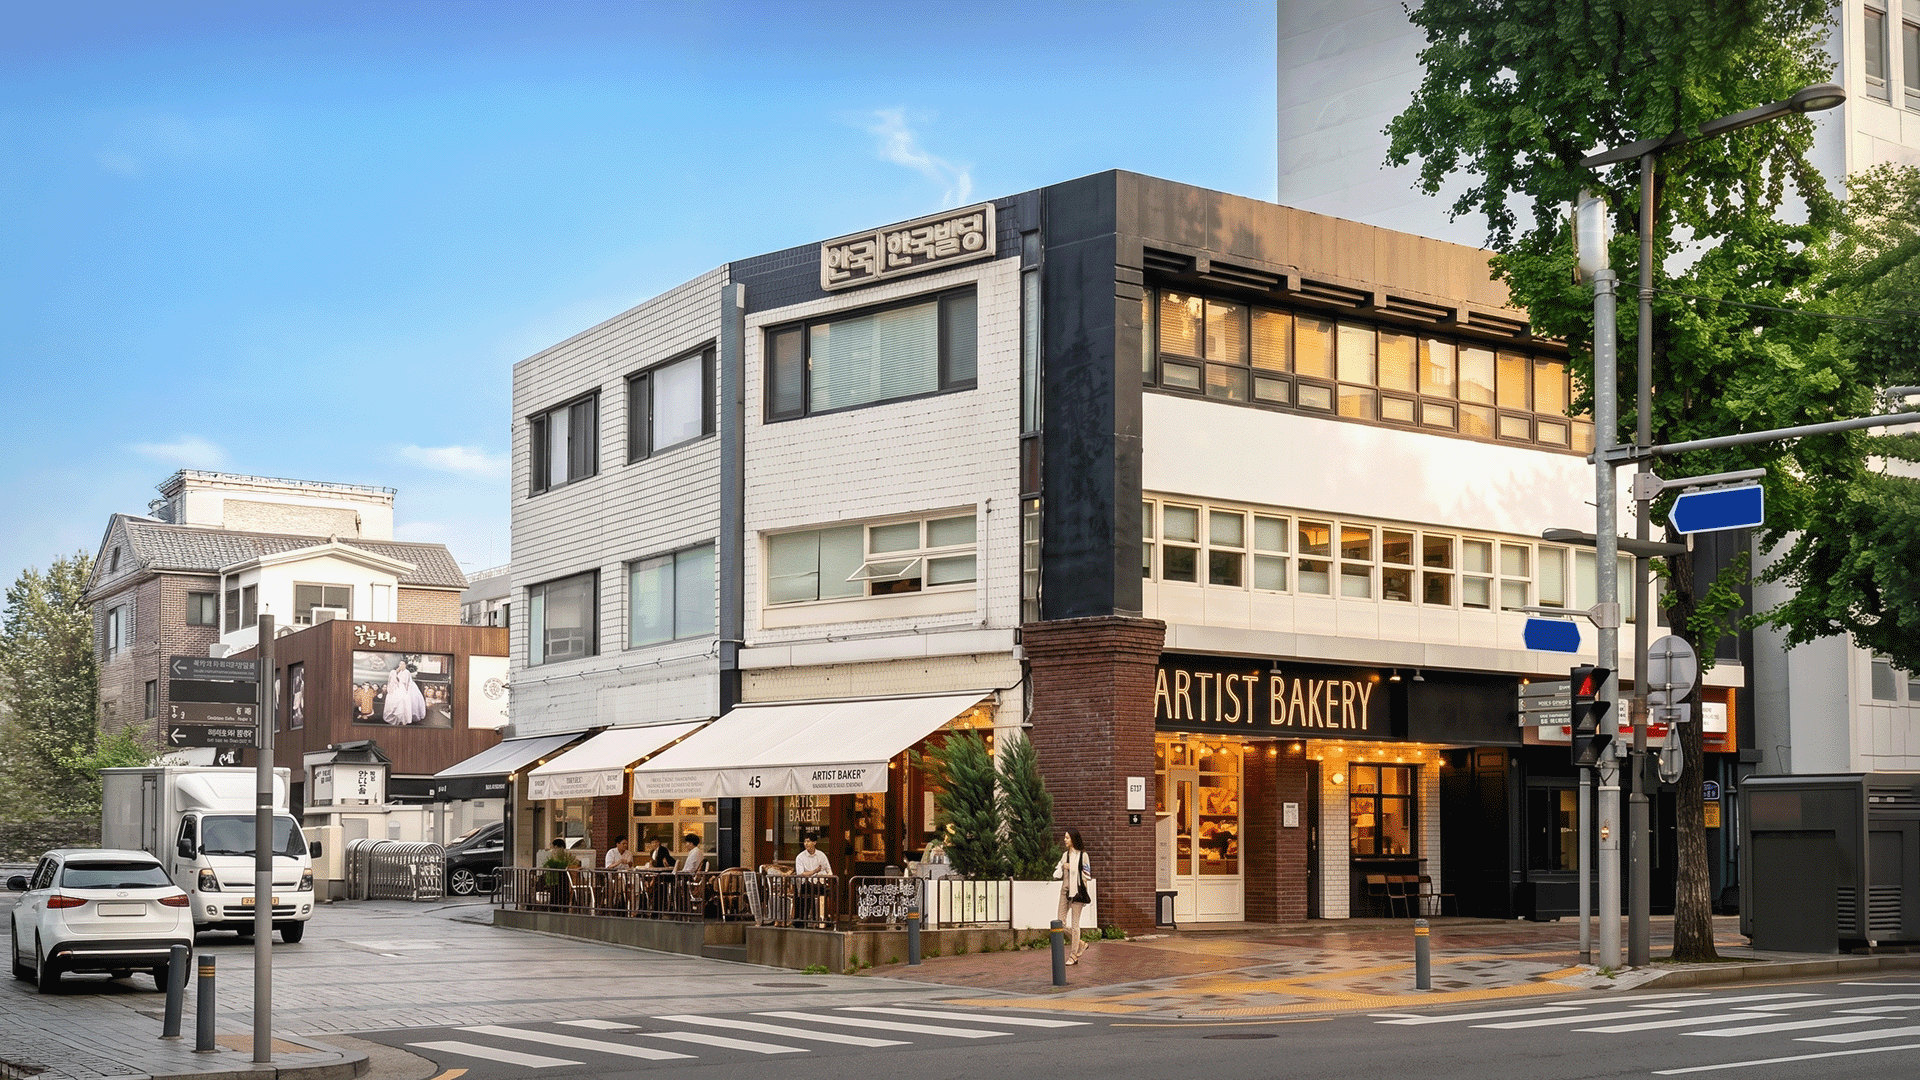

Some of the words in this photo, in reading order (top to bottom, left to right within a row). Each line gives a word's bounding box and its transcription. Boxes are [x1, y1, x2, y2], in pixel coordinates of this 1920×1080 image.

[1154, 668, 1260, 724] ARTIST
[1270, 675, 1373, 730] BAKERY
[812, 770, 836, 780] ARTIST
[749, 776, 761, 788] 45
